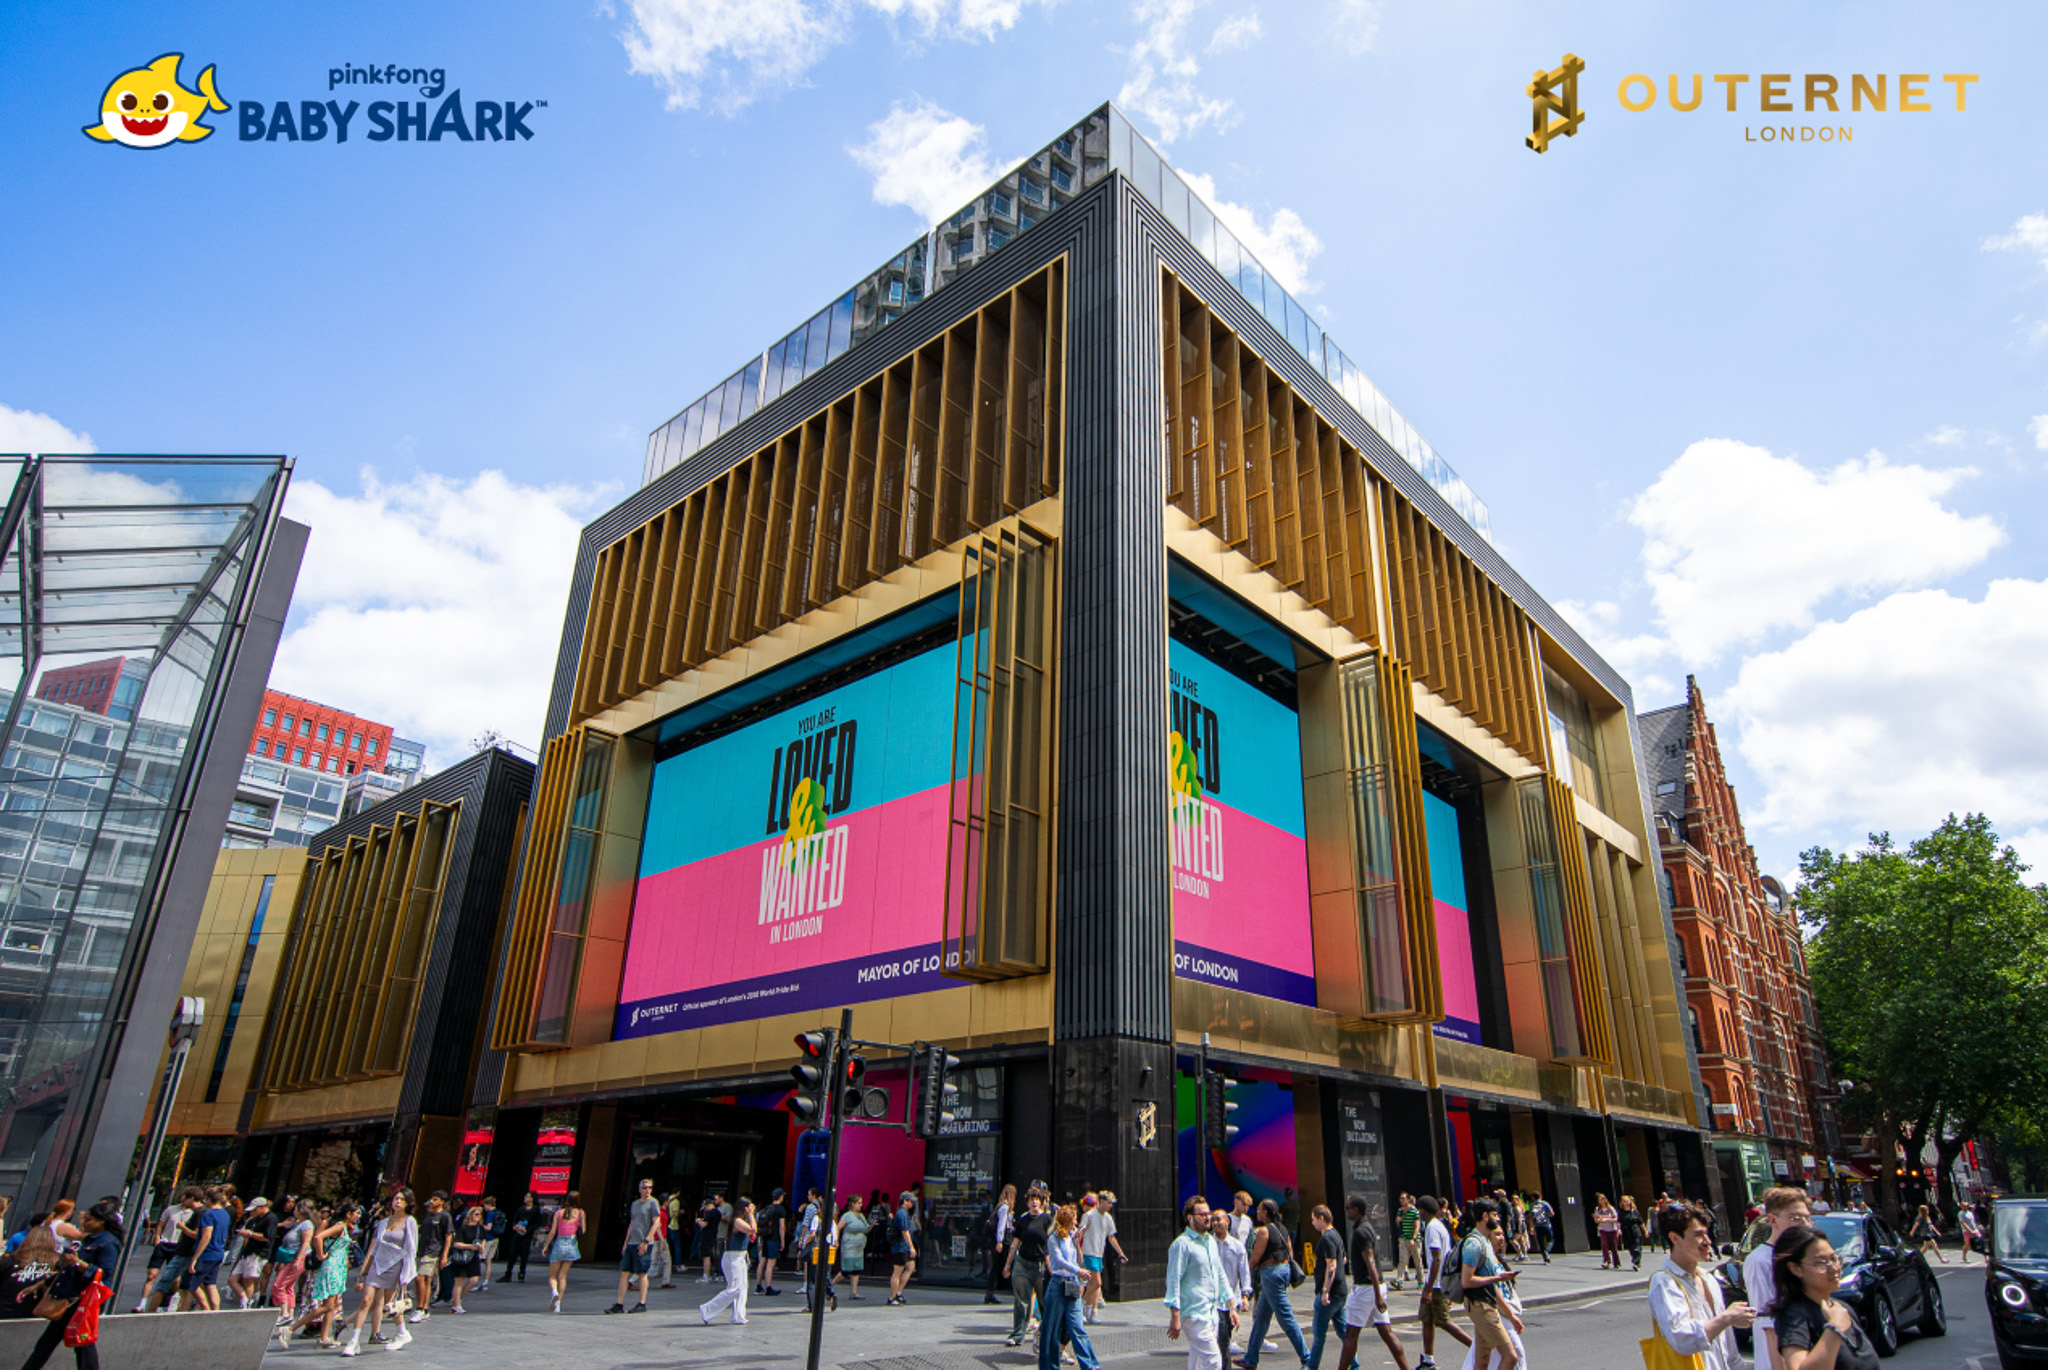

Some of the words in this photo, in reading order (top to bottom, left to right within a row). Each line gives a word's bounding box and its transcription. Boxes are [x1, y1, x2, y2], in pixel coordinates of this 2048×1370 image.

[1169, 668, 1181, 688] OU
[1182, 676, 1199, 699] ARE
[798, 716, 816, 736] YOU
[817, 706, 837, 728] ARE
[766, 719, 858, 836] LOVED
[758, 824, 849, 926] WANTED
[1173, 870, 1210, 900] LONDON
[770, 924, 782, 945] IN
[783, 914, 824, 942] LONDON
[858, 962, 900, 984] MAYOR
[902, 958, 921, 976] OF
[1175, 953, 1190, 971] OF
[1192, 957, 1239, 984] LONDON
[640, 1003, 679, 1017] OUTERNET
[953, 1106, 972, 1119] NOW
